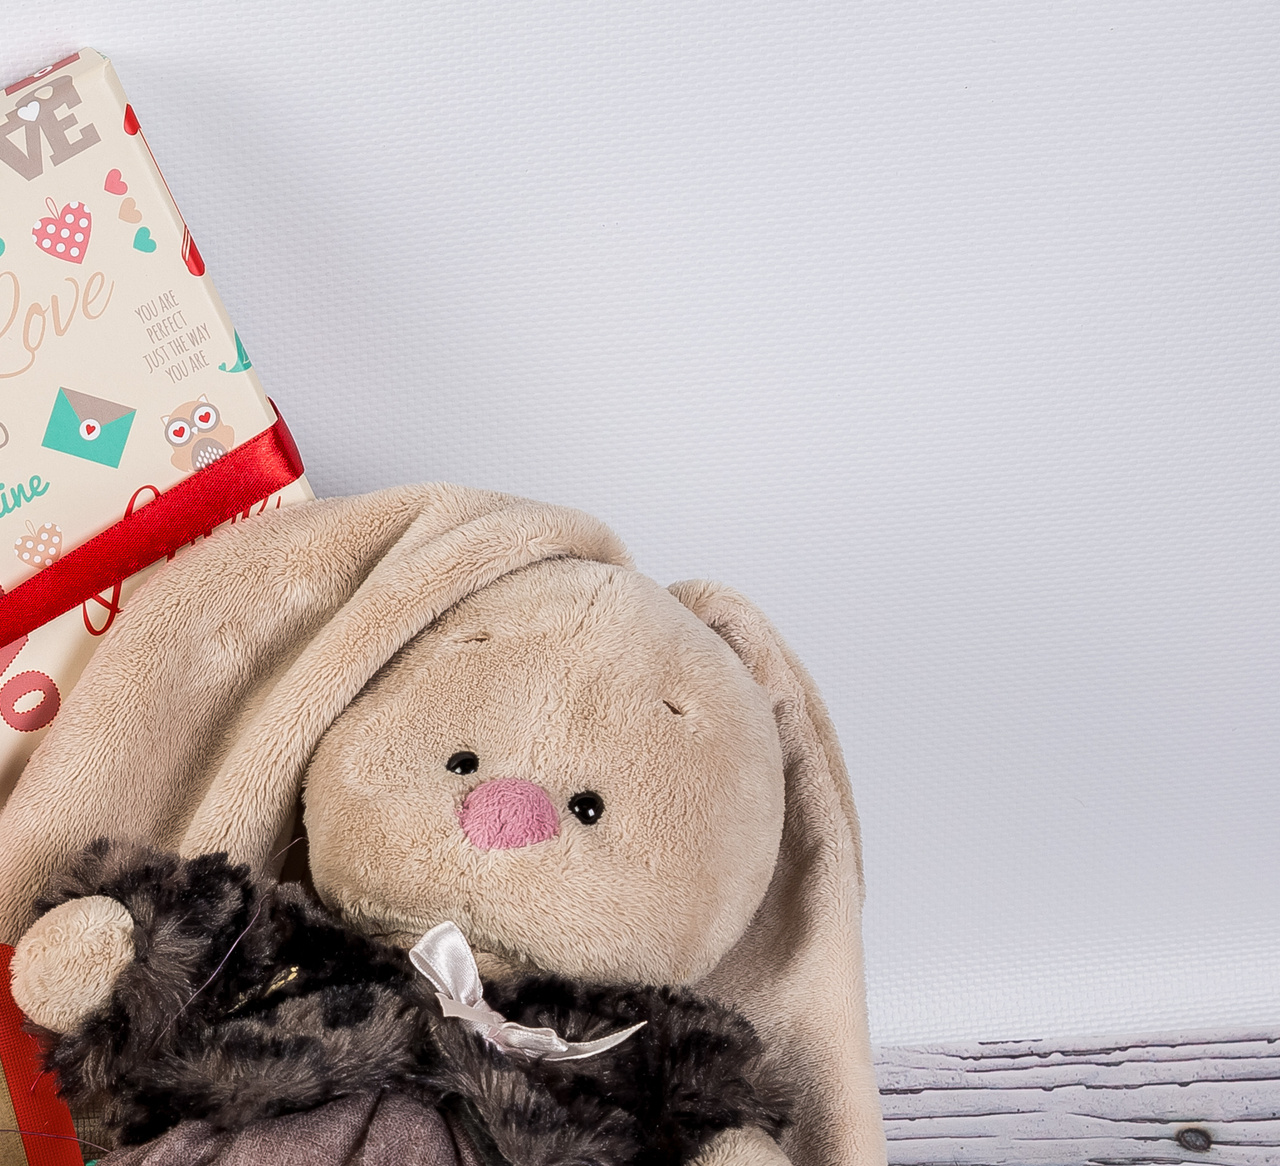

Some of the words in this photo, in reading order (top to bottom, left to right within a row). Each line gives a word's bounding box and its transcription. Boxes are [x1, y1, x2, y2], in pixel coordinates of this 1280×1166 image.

[134, 300, 158, 324] YOU
[158, 290, 179, 312] ARE
[146, 310, 187, 344] PERFECT
[143, 345, 170, 374] JUST
[167, 336, 189, 356] THE
[186, 323, 211, 347] WAY
[165, 360, 189, 383] YOU
[189, 350, 210, 373] ARE
